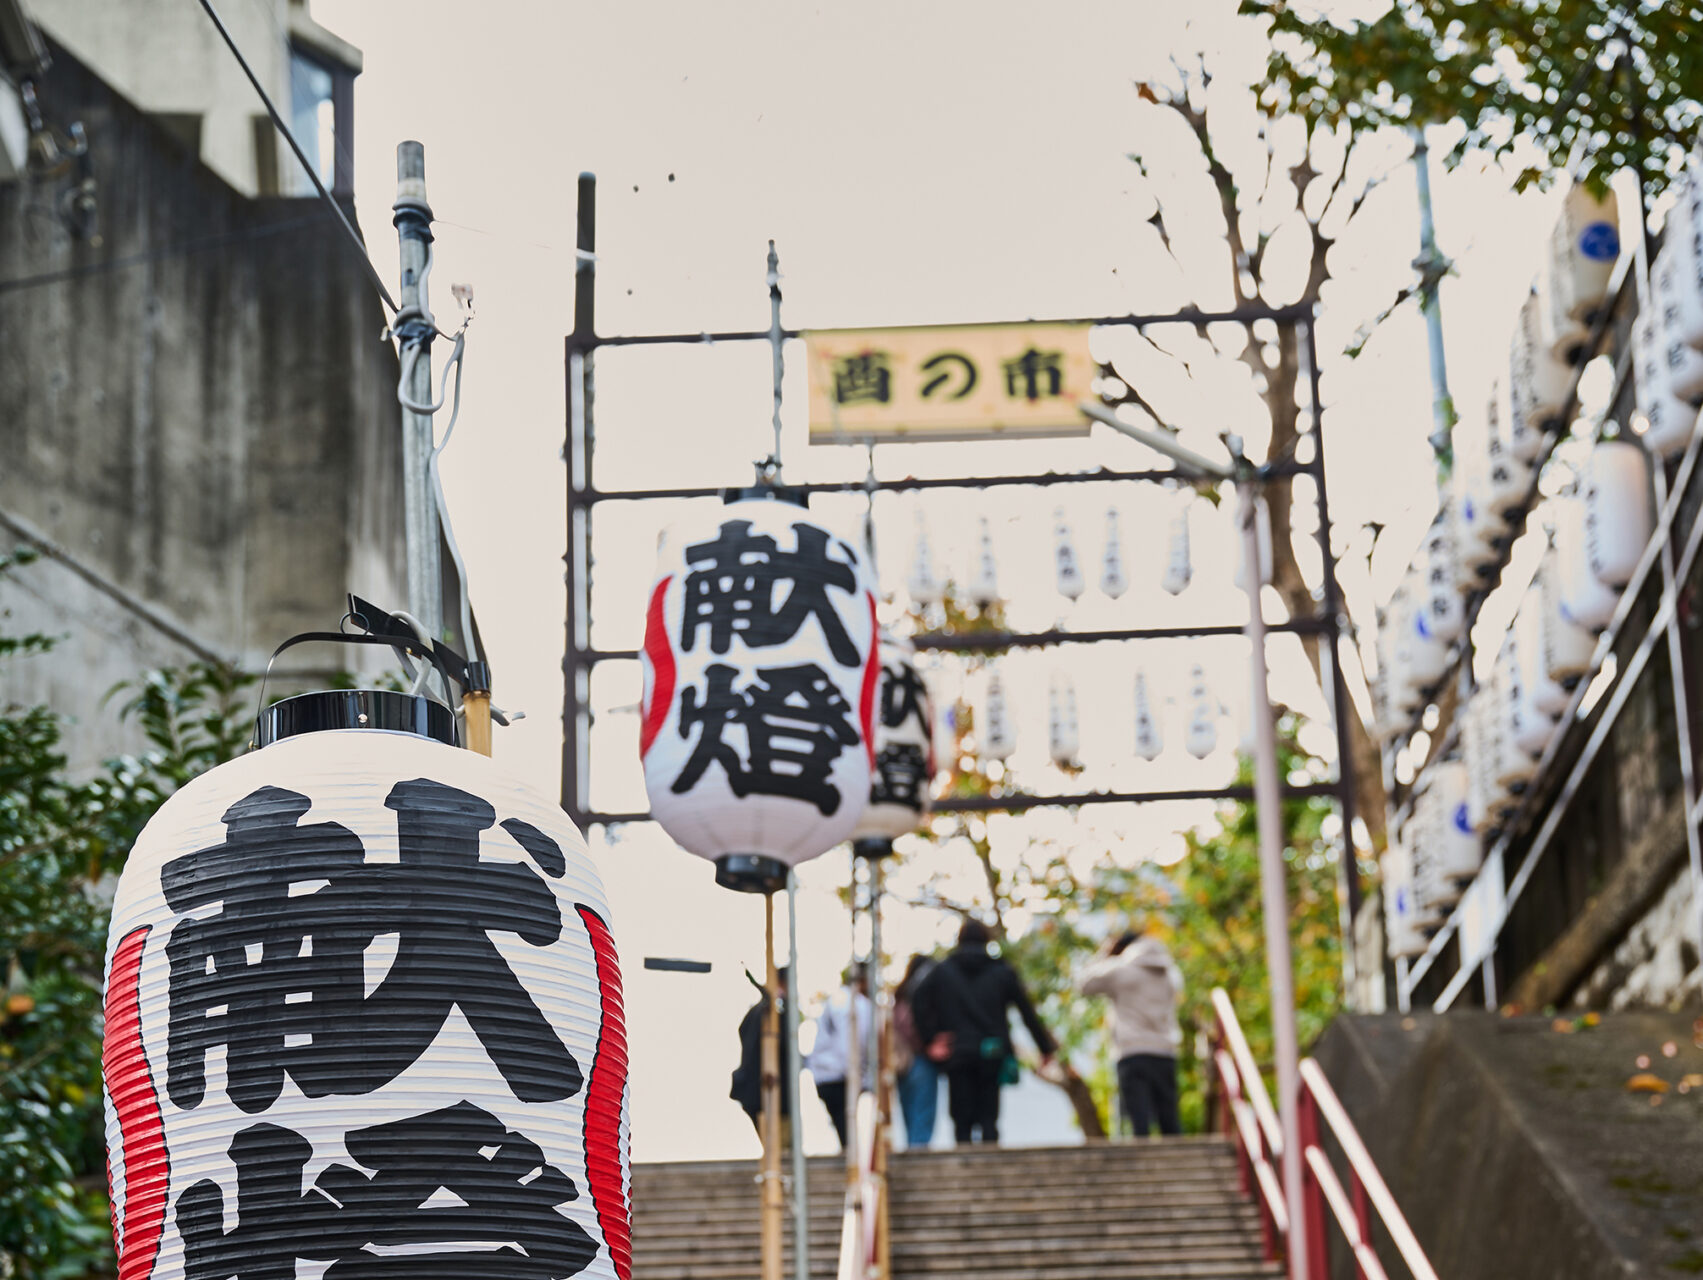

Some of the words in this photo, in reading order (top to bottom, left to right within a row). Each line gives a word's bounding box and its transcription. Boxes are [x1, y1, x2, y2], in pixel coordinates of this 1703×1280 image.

[835, 349, 1063, 404] 酉の市
[671, 519, 861, 817] 献燈
